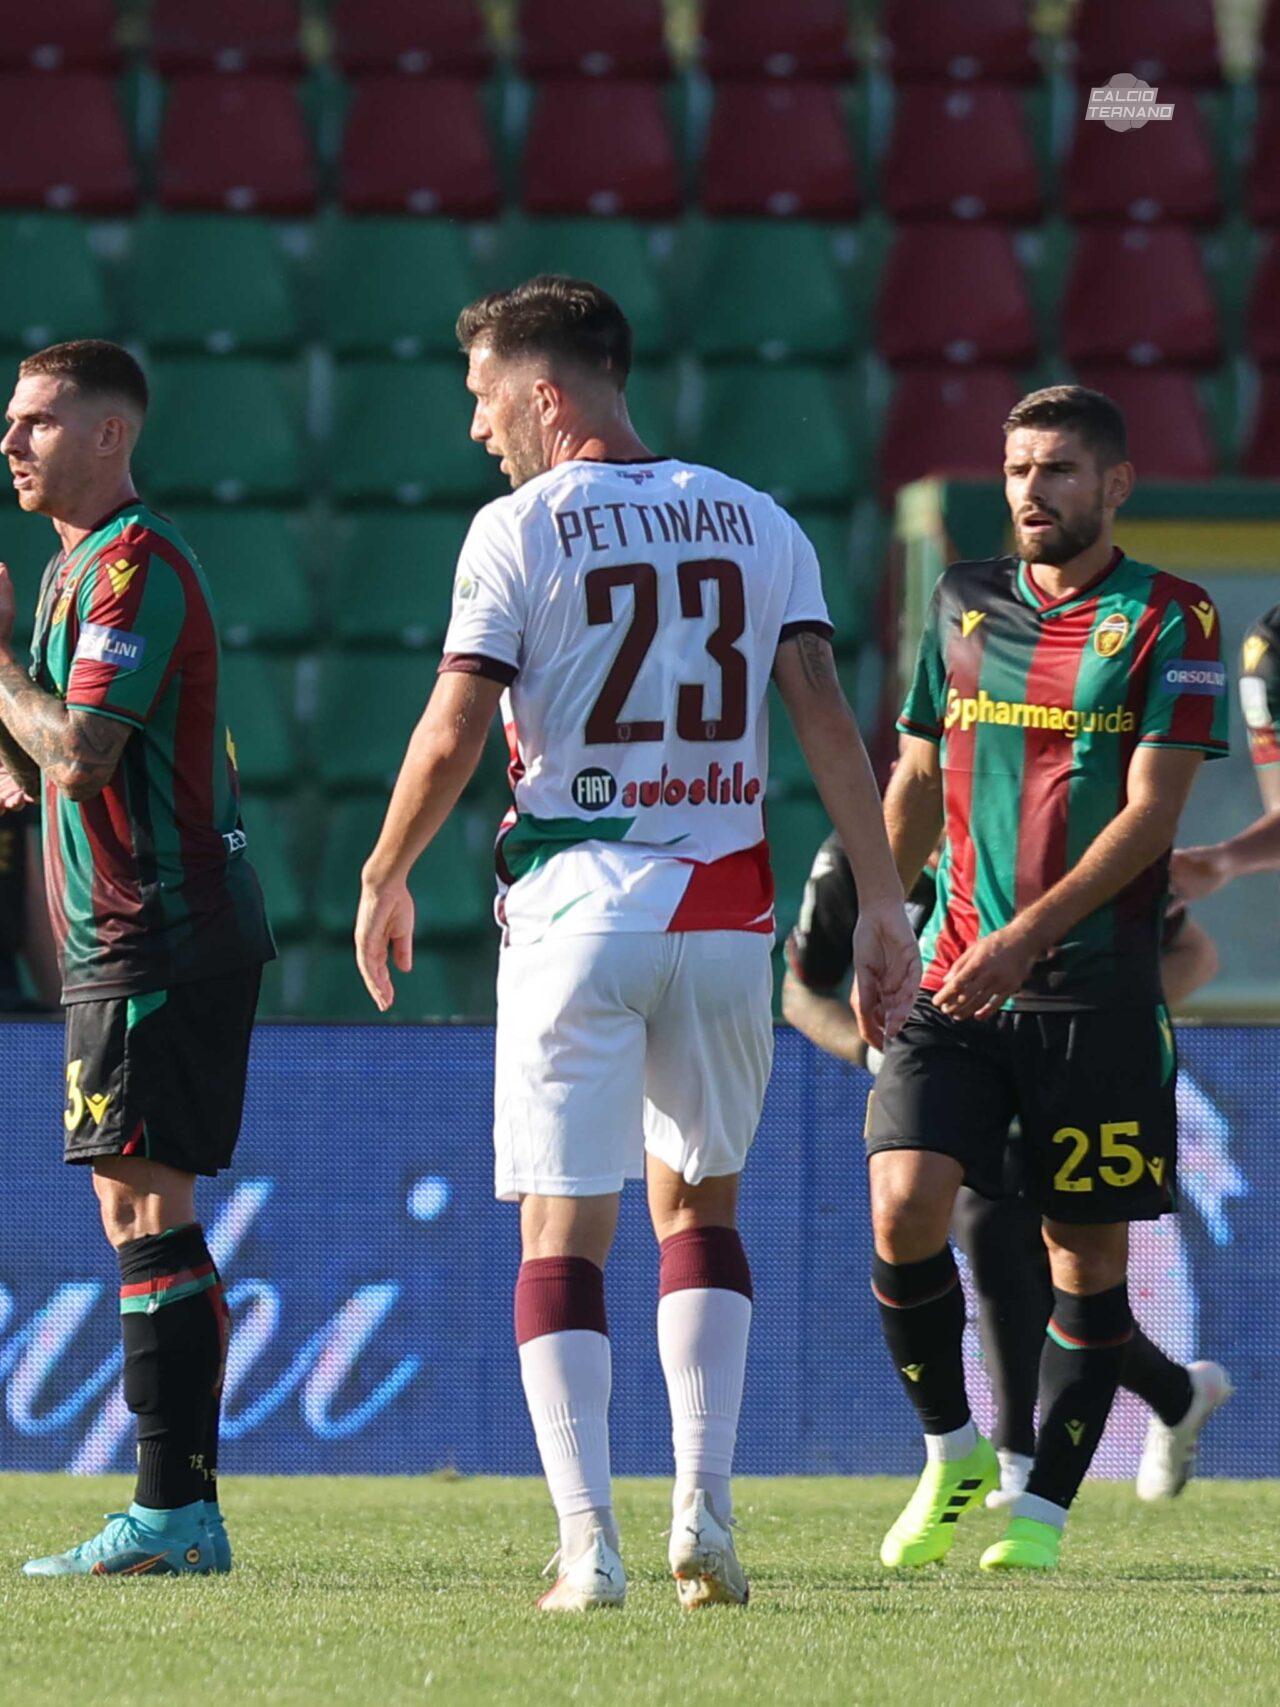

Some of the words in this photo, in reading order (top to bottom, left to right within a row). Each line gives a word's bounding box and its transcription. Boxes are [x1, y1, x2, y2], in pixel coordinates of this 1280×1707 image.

[557, 498, 754, 558] PETTINARI
[584, 558, 748, 745] 23
[577, 775, 612, 804] FIAT
[622, 761, 760, 809] autostile
[1051, 1119, 1147, 1193] 25
